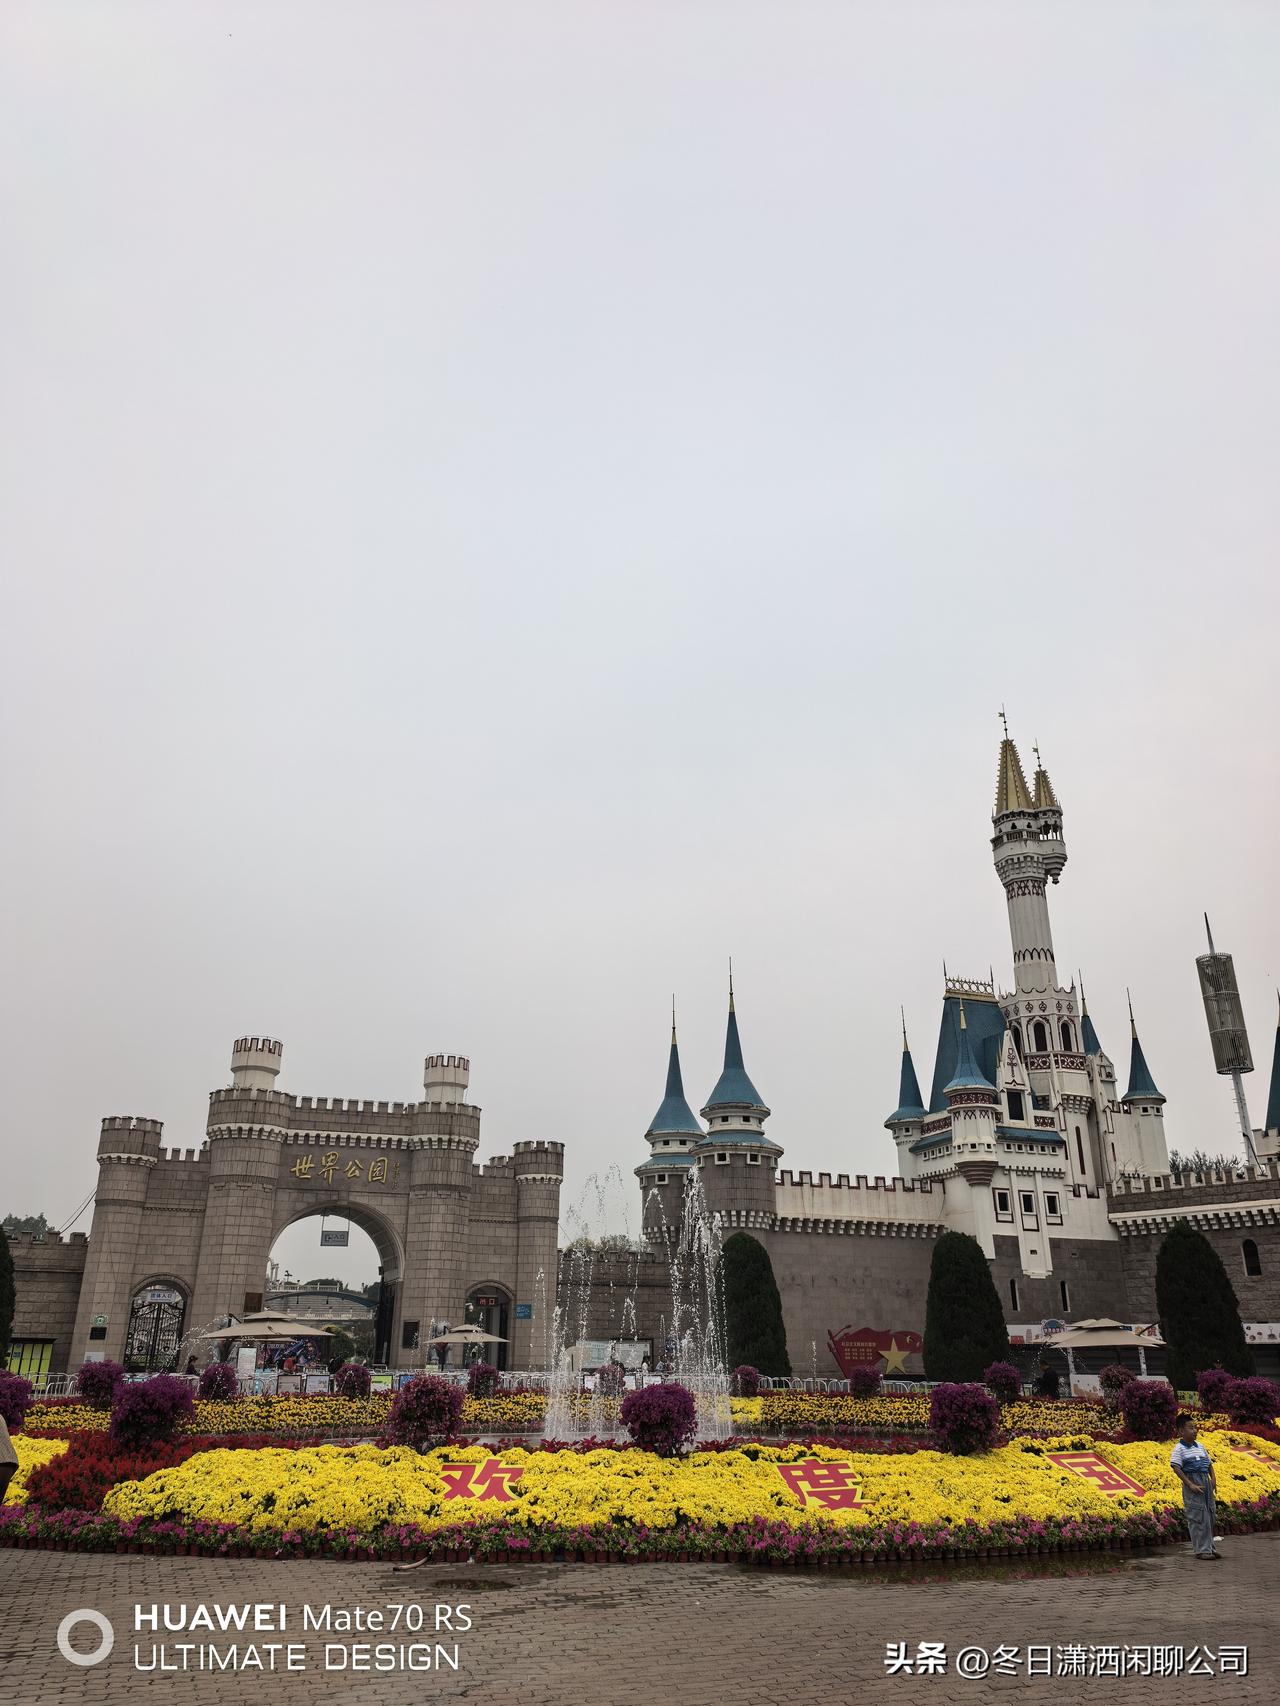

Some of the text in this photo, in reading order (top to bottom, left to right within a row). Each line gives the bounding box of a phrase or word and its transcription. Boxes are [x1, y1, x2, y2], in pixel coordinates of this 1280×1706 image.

[290, 1151, 388, 1184] 世界公园
[441, 1458, 525, 1501] 欢
[776, 1458, 876, 1511] 度
